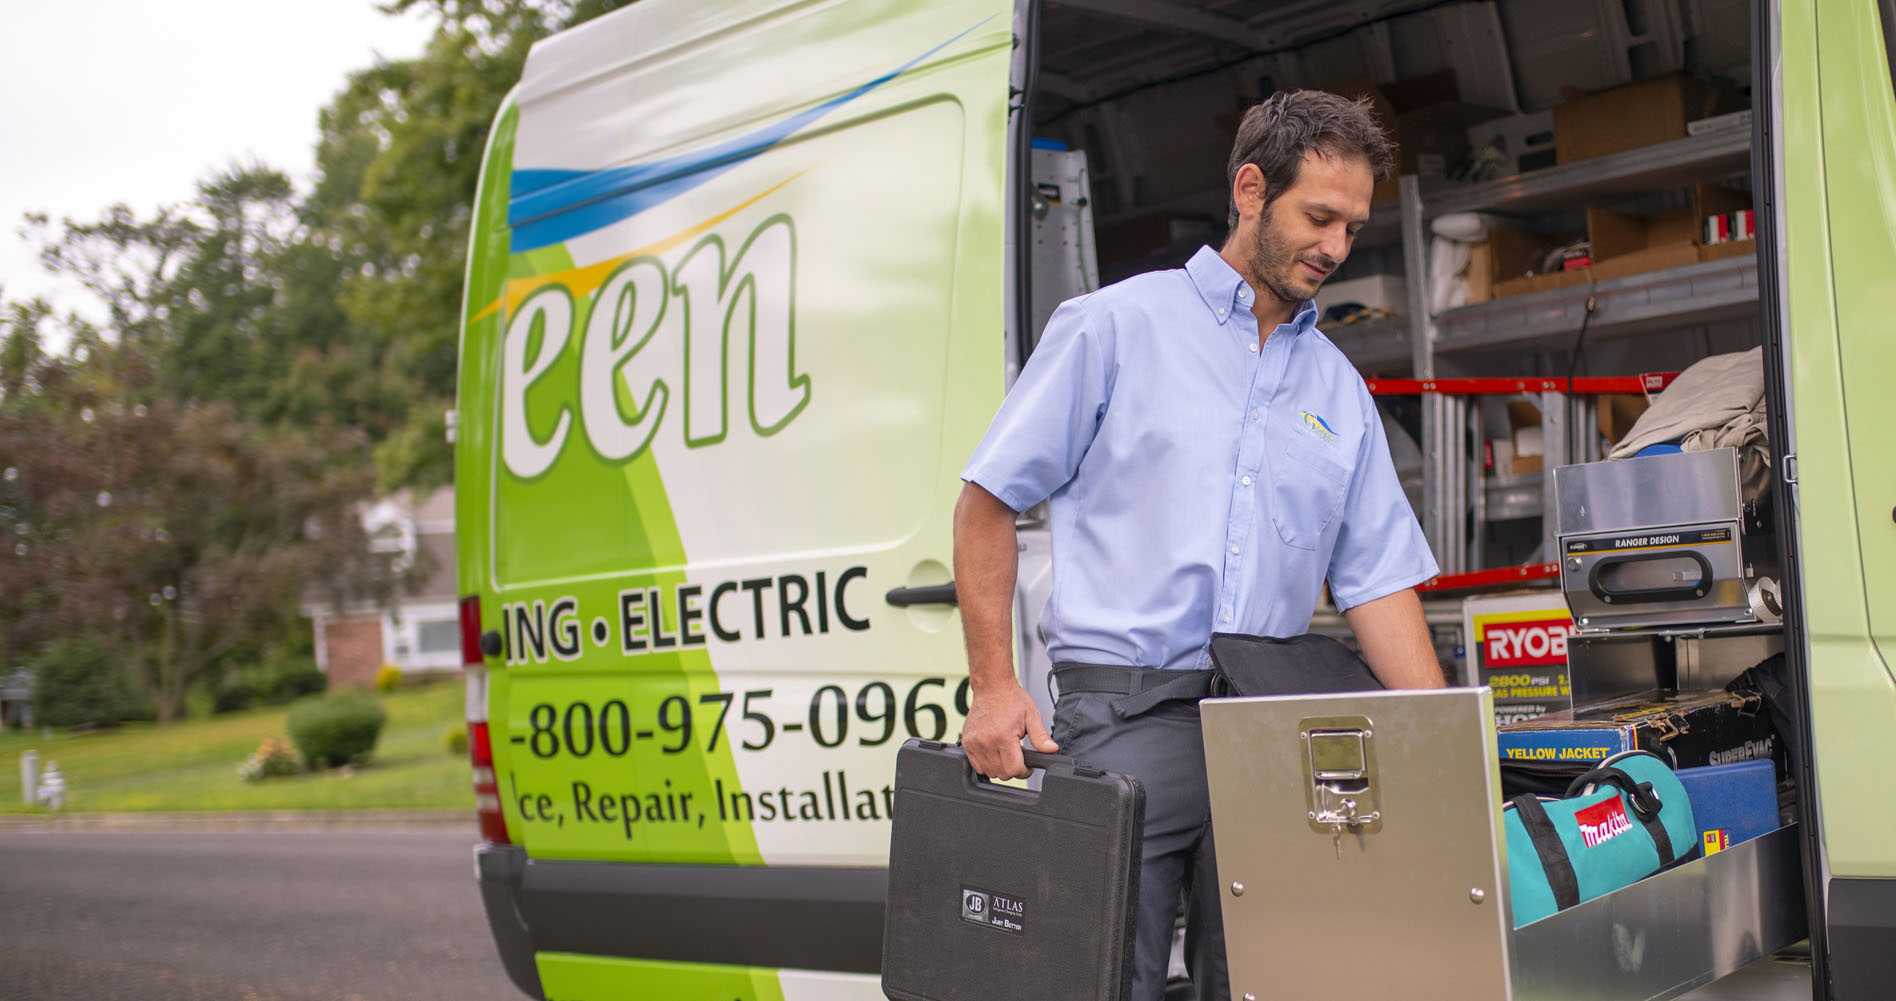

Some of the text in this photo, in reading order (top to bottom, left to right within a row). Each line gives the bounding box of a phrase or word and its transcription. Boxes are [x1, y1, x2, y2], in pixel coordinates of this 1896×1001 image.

[1615, 535, 1680, 548] RANGER DESIGN
[503, 565, 871, 661] ING ELECTRIC
[1511, 685, 1557, 697] PRESSURE
[1506, 747, 1610, 760] YELLOW JACKET
[571, 777, 705, 840] Repair,
[1579, 811, 1633, 849] makita
[969, 895, 982, 912] JB
[993, 896, 1023, 913] ATLAS
